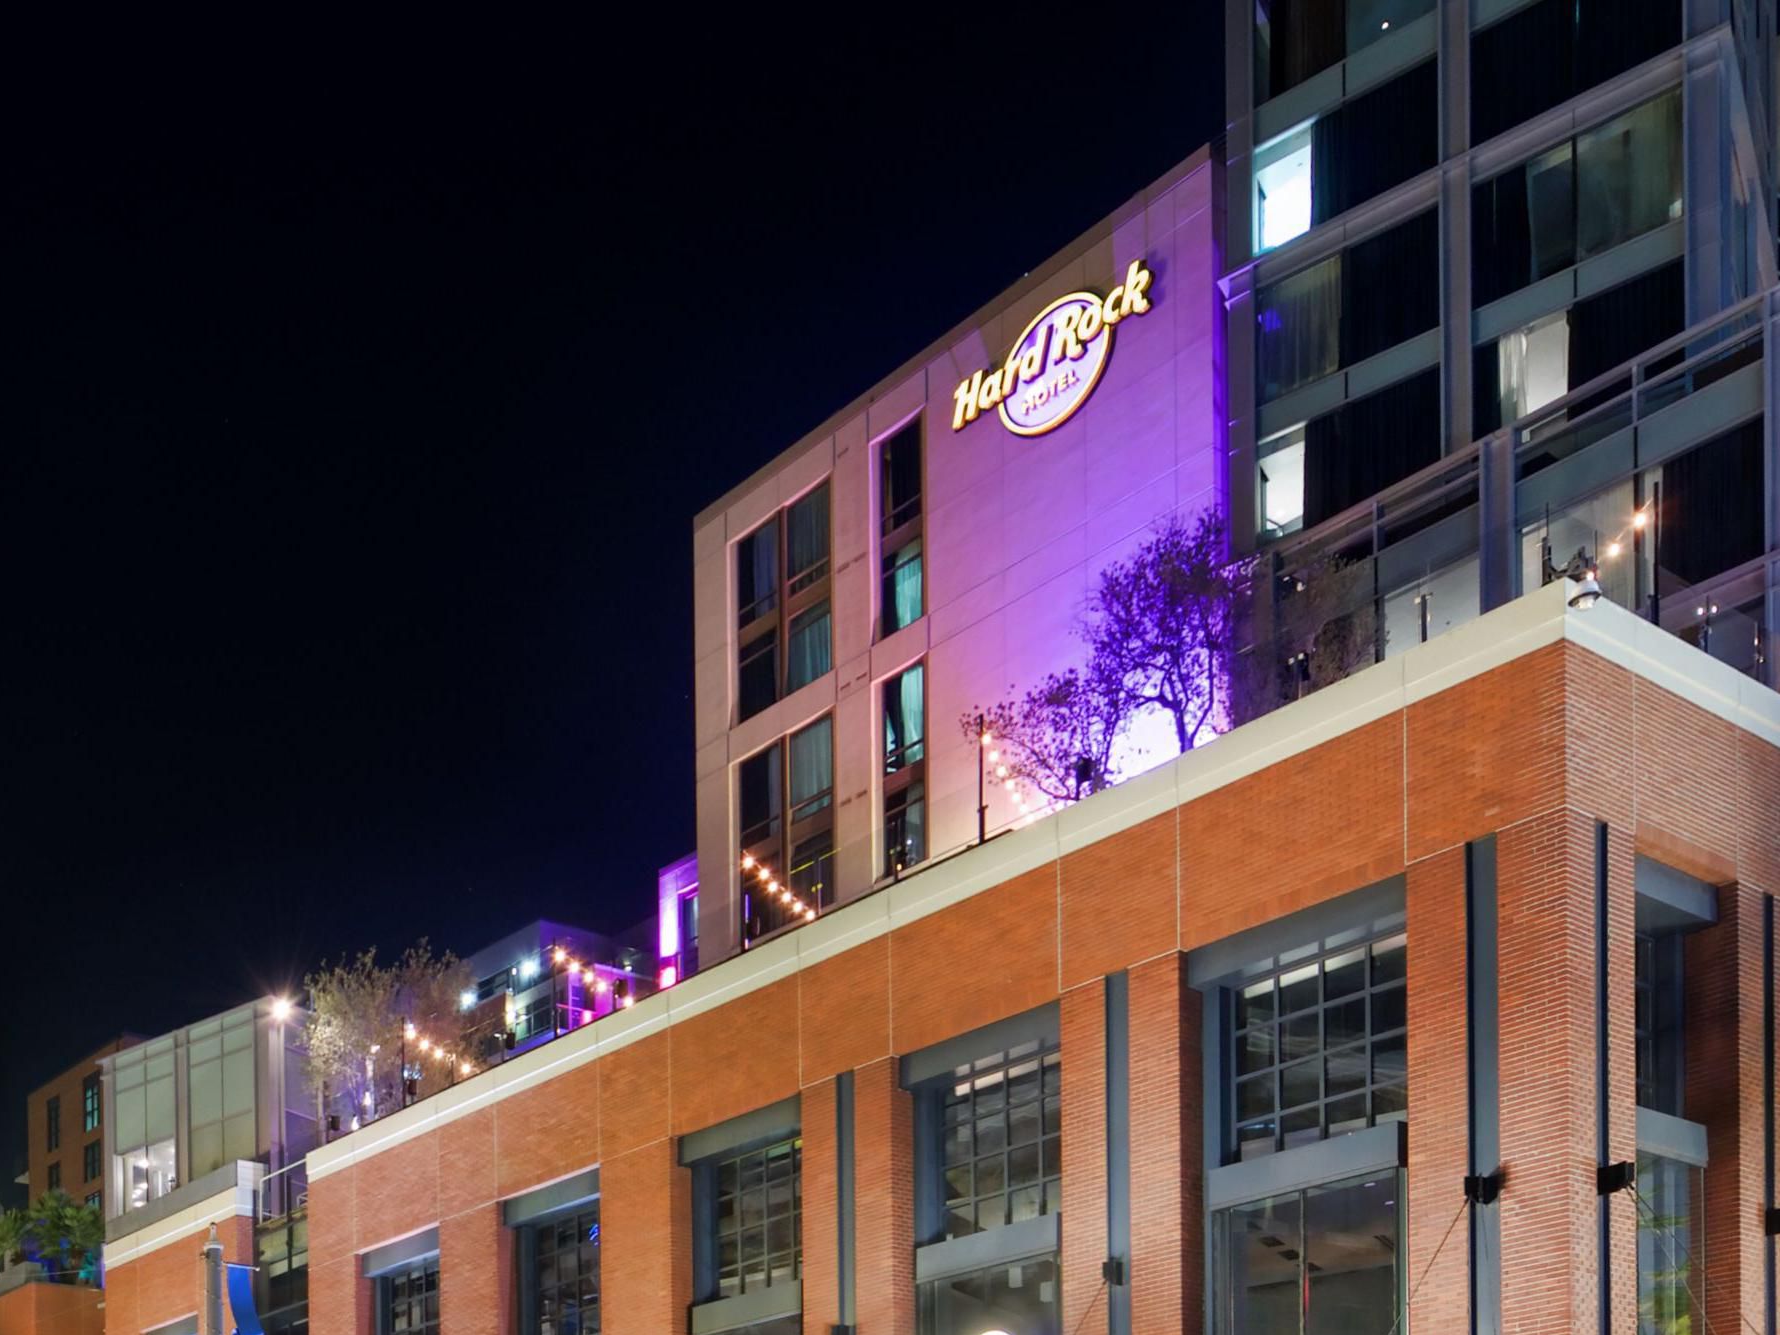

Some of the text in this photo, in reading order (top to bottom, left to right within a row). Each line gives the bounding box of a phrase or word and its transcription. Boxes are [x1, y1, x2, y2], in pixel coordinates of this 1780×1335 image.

[951, 260, 1154, 431] Hard Rock
[1022, 369, 1080, 416] HOTEL
